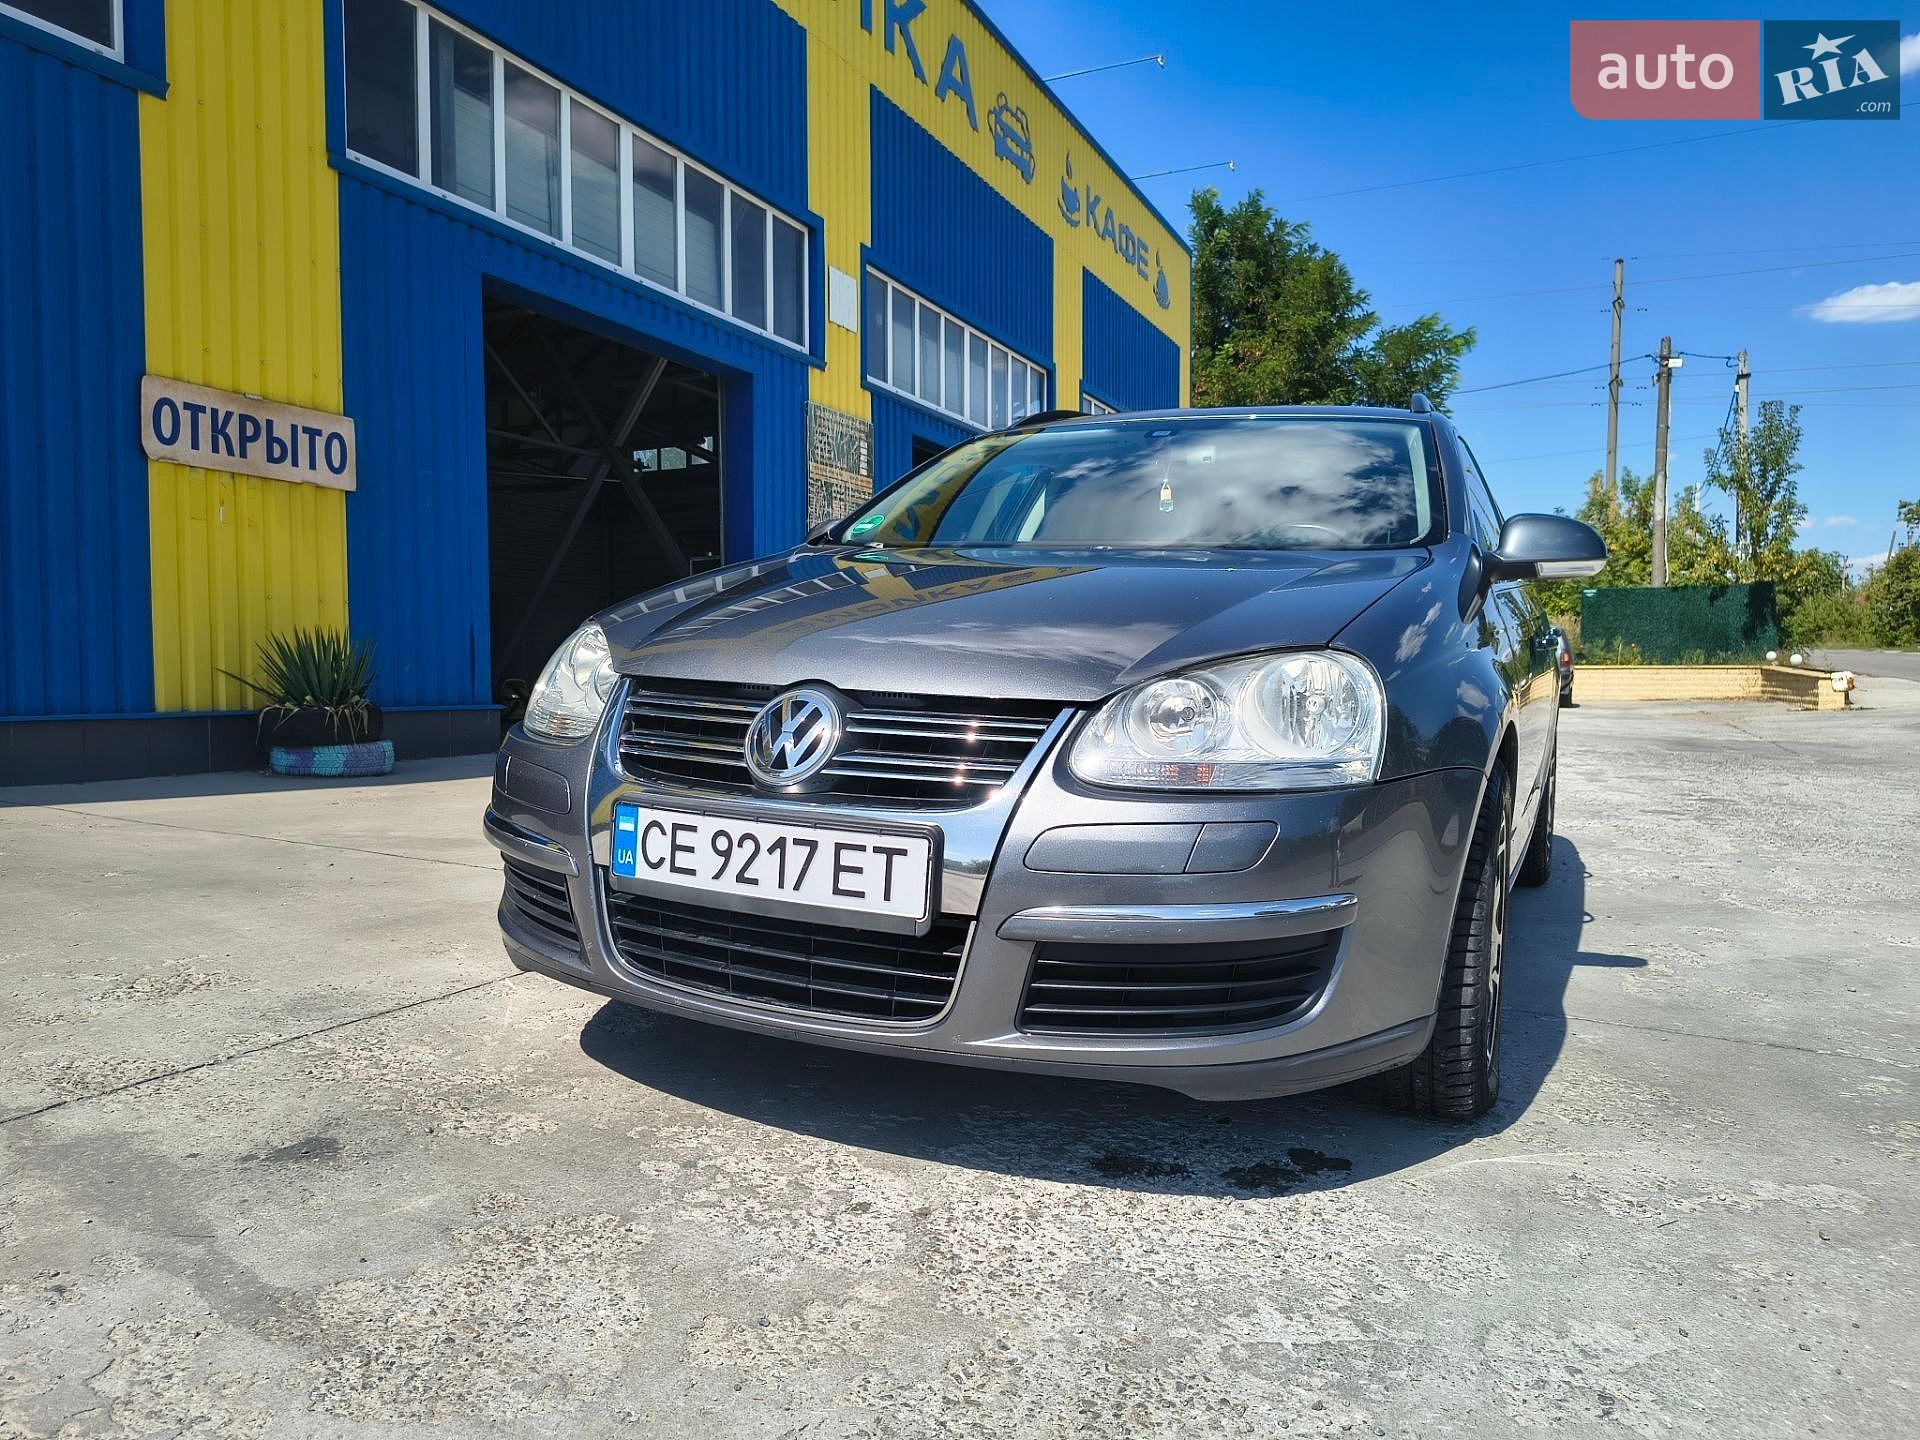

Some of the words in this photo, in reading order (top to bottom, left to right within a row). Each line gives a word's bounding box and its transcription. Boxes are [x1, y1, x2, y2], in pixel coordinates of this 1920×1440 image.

[1086, 184, 1149, 282] КАФЕ
[152, 397, 348, 475] ОТКРЫТО
[618, 849, 634, 866] UA
[641, 820, 698, 876] CE
[711, 829, 818, 892] 9217
[832, 842, 908, 902] ET
